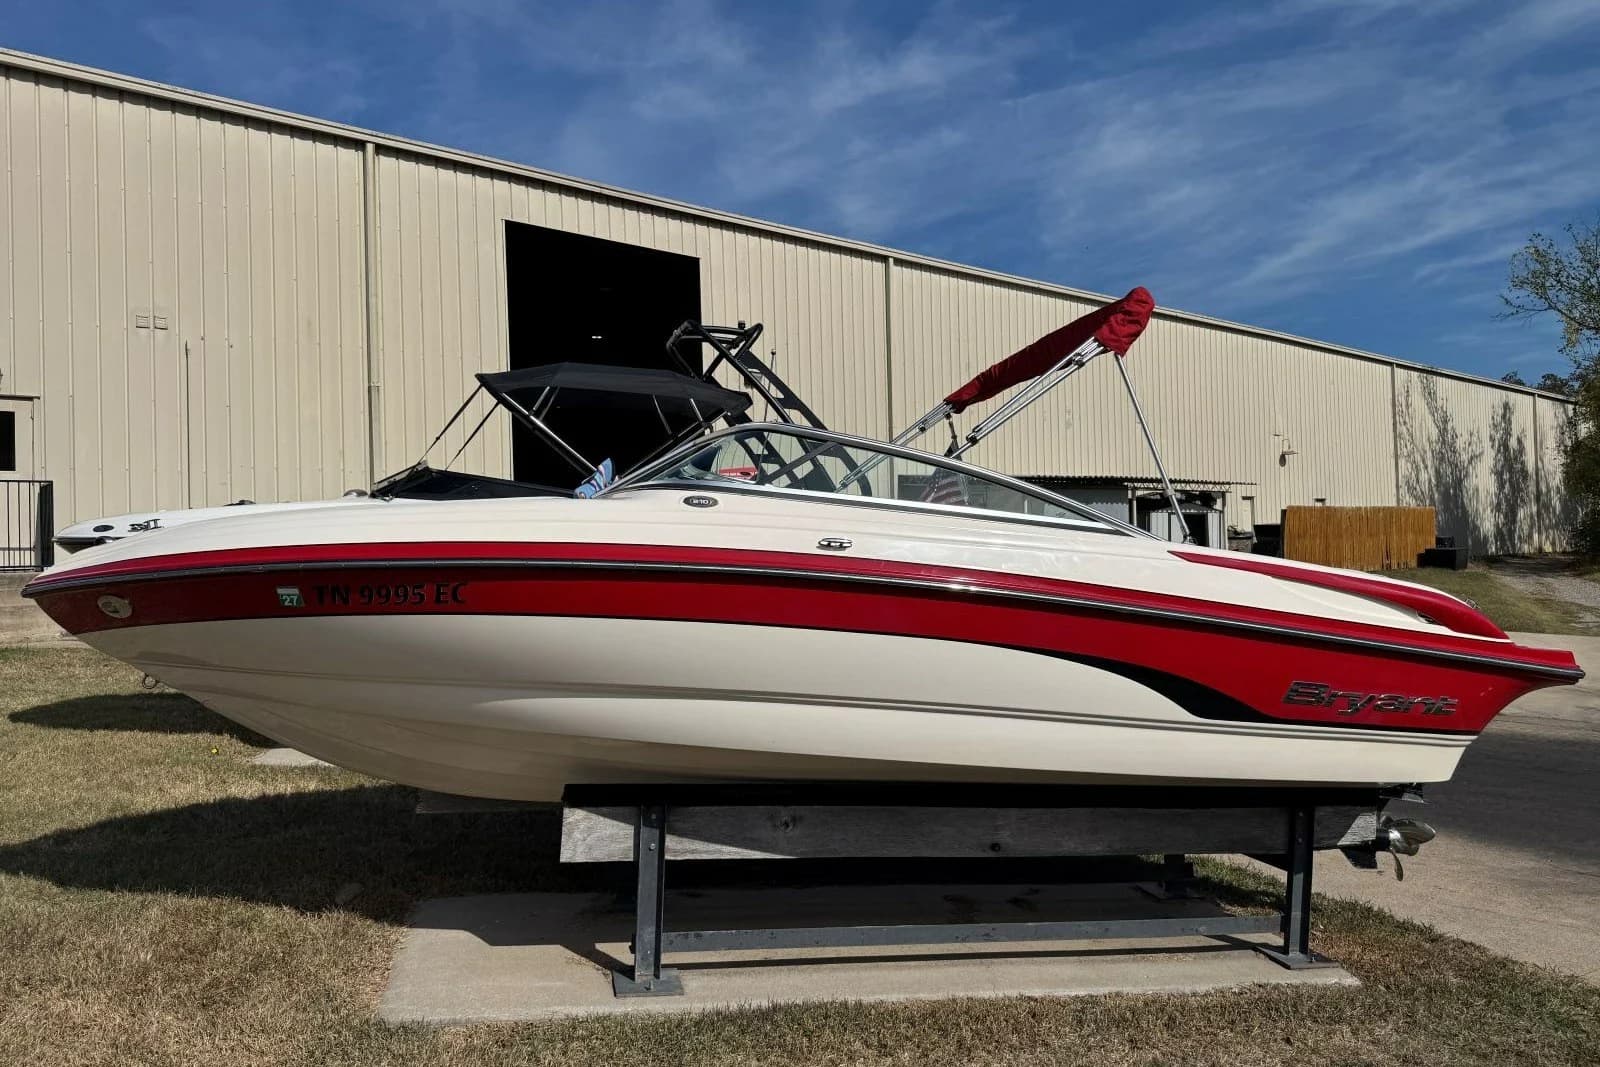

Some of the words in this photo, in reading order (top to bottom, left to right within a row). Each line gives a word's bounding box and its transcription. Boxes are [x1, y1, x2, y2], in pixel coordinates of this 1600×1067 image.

[284, 595, 298, 606] 27
[312, 584, 350, 605] TN
[359, 584, 426, 605] 9995
[434, 582, 467, 604] EC
[1283, 681, 1458, 715] Bryant
